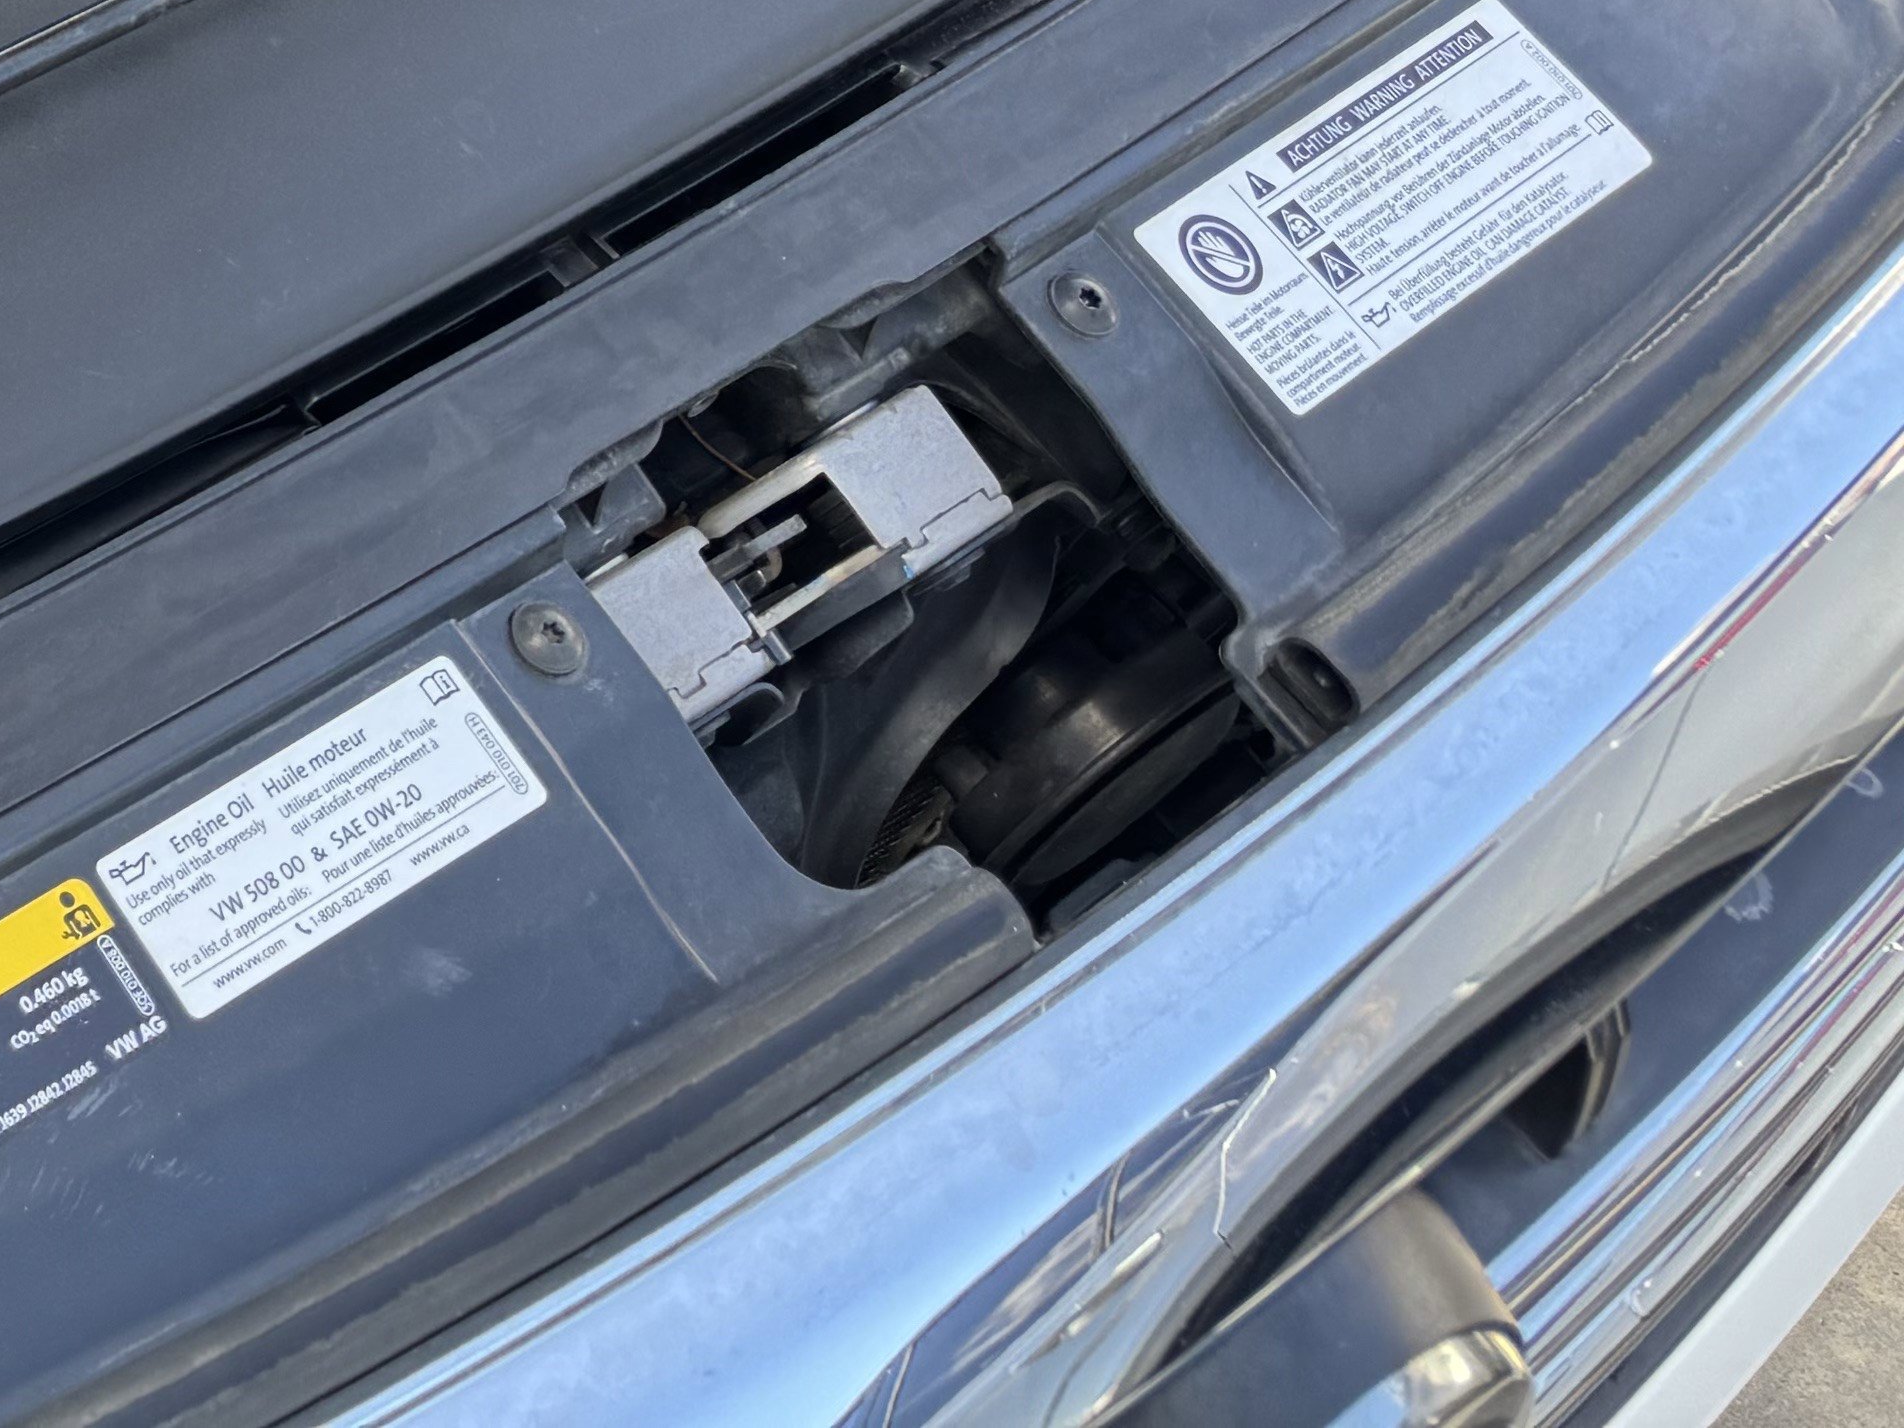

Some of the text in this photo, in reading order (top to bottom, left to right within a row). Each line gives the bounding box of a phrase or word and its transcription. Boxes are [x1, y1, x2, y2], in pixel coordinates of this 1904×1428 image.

[1283, 28, 1483, 166] ACHTUNG WARNING ATTENTION
[1308, 182, 1350, 214] RADIATOR
[1344, 172, 1365, 189] FAN
[1360, 159, 1383, 178] MAY
[1377, 144, 1405, 167] START
[1399, 138, 1415, 152] AT
[1409, 126, 1432, 145] ANY
[1367, 179, 1382, 192] de
[1343, 231, 1370, 253] HIGH
[260, 727, 369, 798] Huile moteur
[277, 716, 438, 819] Utilisez uniquement de l'huile
[475, 727, 496, 750] 043
[491, 749, 511, 771] 010
[289, 736, 439, 838] qui satisfait expressément à
[506, 770, 525, 790] 701
[167, 793, 255, 859] Engine Oil
[208, 782, 424, 924] VW 508 00 & SAE 0W-20
[322, 767, 501, 883] Pour une liste d'huiles approuvées:
[408, 822, 471, 867] www.vw.ca
[125, 817, 269, 910] Use only oil that expressly
[135, 871, 216, 928] complies with
[309, 868, 394, 927] 1-800-822-8987
[170, 882, 312, 977] For a list of approved oils:
[17, 963, 90, 1014] 0.460 kg
[212, 937, 287, 989] www.vw.com
[33, 988, 101, 1038] eq 0.0018 t
[103, 1014, 168, 1061] VW AG
